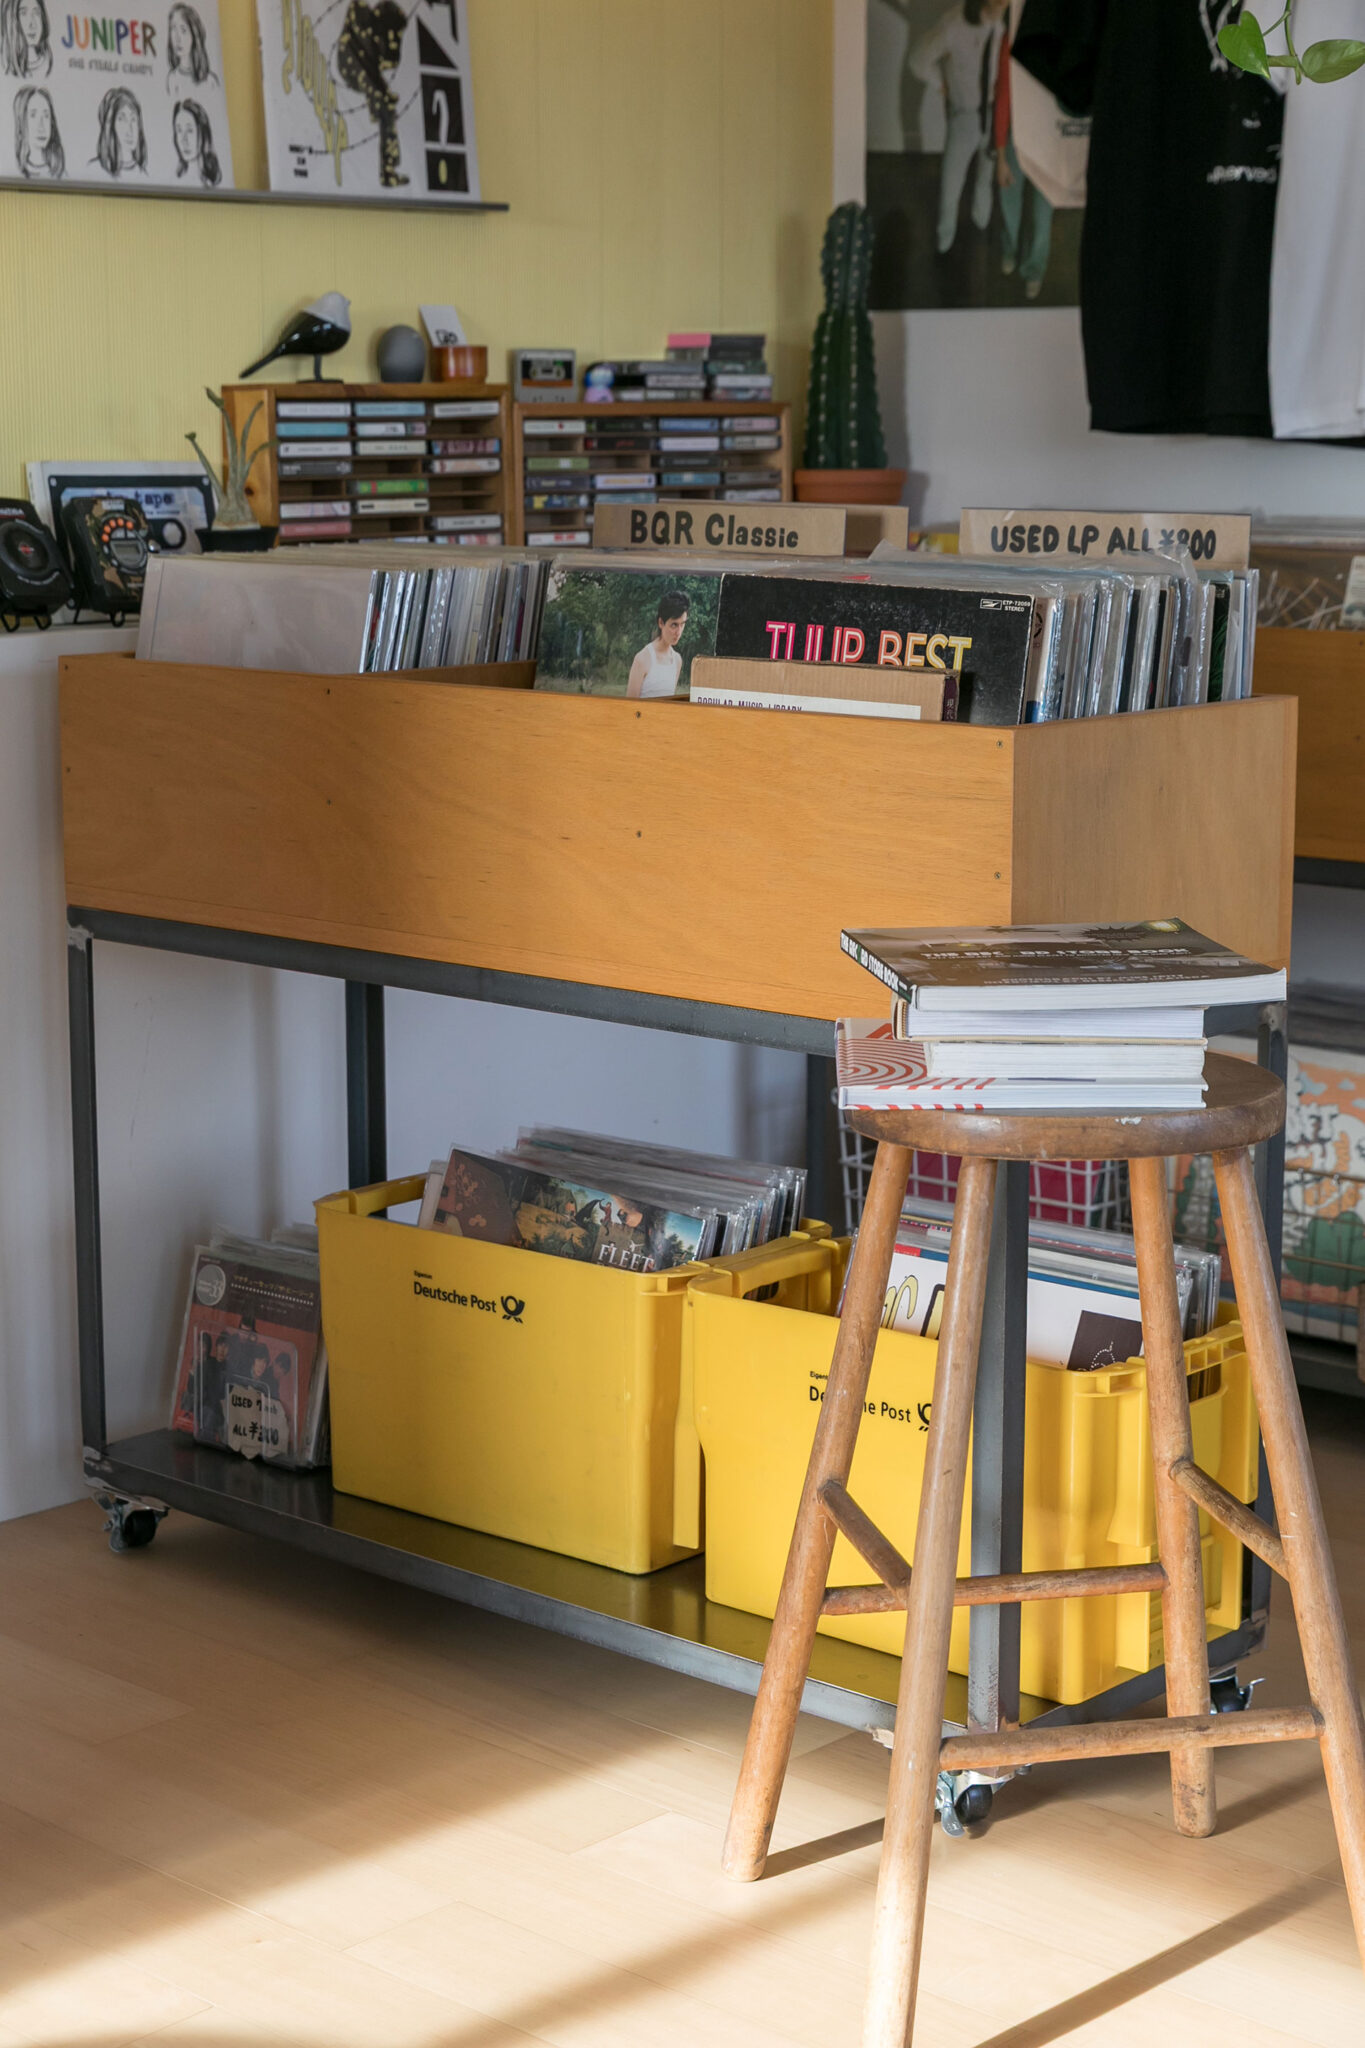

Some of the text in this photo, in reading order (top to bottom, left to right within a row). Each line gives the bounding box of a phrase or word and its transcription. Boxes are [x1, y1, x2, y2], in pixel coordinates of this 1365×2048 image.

[61, 14, 157, 58] JUNIPER
[630, 509, 799, 548] BQR Classic
[990, 525, 1060, 553] USED
[1067, 525, 1099, 556] LP
[1107, 527, 1155, 555] ALL
[877, 630, 973, 675] BEST
[598, 1244, 655, 1272] FLEET
[414, 1281, 497, 1313] Deutsche Post
[231, 1394, 253, 1409] USED
[881, 1401, 911, 1423] Post
[233, 1424, 247, 1437] ALL
